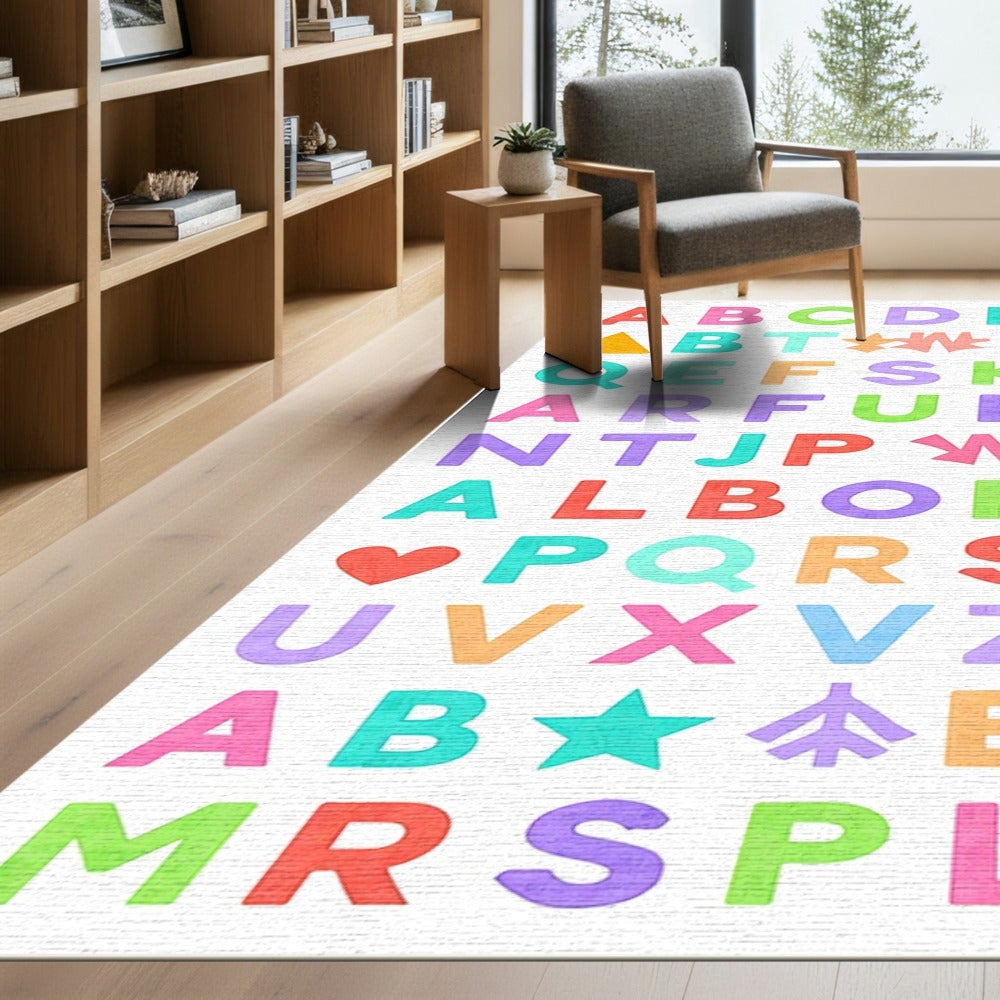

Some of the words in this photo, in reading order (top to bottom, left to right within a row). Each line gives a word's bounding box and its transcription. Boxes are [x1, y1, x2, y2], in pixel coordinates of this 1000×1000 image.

[698, 307, 762, 325] B
[788, 307, 855, 325] C
[884, 307, 960, 325] D
[672, 332, 742, 353] B
[765, 332, 838, 352] T
[535, 360, 629, 389] Q
[661, 361, 736, 385] E
[762, 361, 835, 384] F
[862, 361, 941, 385] S
[487, 395, 579, 422] A
[619, 394, 712, 422] R
[745, 395, 824, 422] F
[853, 394, 939, 423] U
[437, 434, 570, 466] N
[601, 434, 695, 466] T
[695, 433, 766, 467] J
[783, 434, 874, 466] P
[384, 480, 497, 519] A
[551, 480, 646, 519] L
[687, 480, 785, 520] B
[822, 481, 940, 519] O
[483, 536, 608, 584] P
[626, 536, 754, 592] Q
[796, 536, 908, 584] R
[236, 605, 395, 665] U
[446, 605, 583, 664] V
[591, 605, 756, 664] X
[798, 605, 933, 664] V
[106, 691, 278, 767] A
[328, 690, 487, 768] B
[0, 802, 257, 905] M
[242, 802, 451, 905] R
[496, 800, 668, 908] S
[725, 802, 890, 905] P
